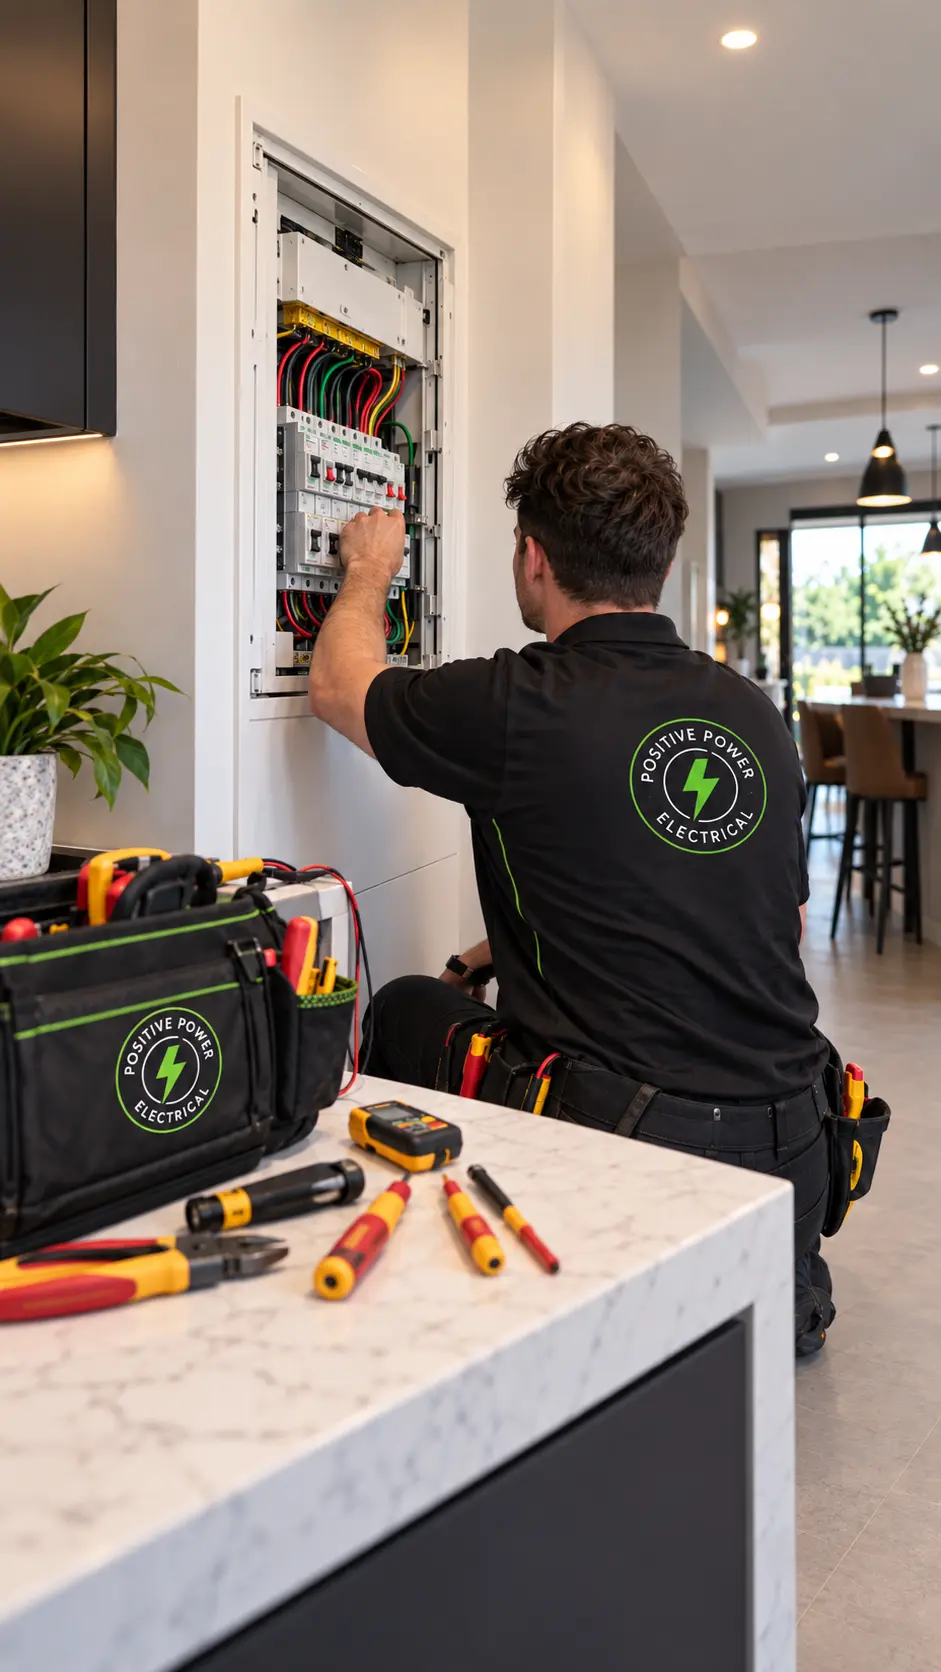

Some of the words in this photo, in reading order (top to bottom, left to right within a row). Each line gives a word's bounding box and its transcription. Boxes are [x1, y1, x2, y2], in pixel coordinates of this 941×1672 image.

[641, 728, 696, 783] POSITIVE
[703, 730, 755, 779] POWER
[656, 811, 754, 844] ELECTRICAL
[124, 1017, 172, 1075] POSITIVE
[177, 1017, 214, 1060] POWER
[134, 1088, 210, 1124] ELECTRICAL
